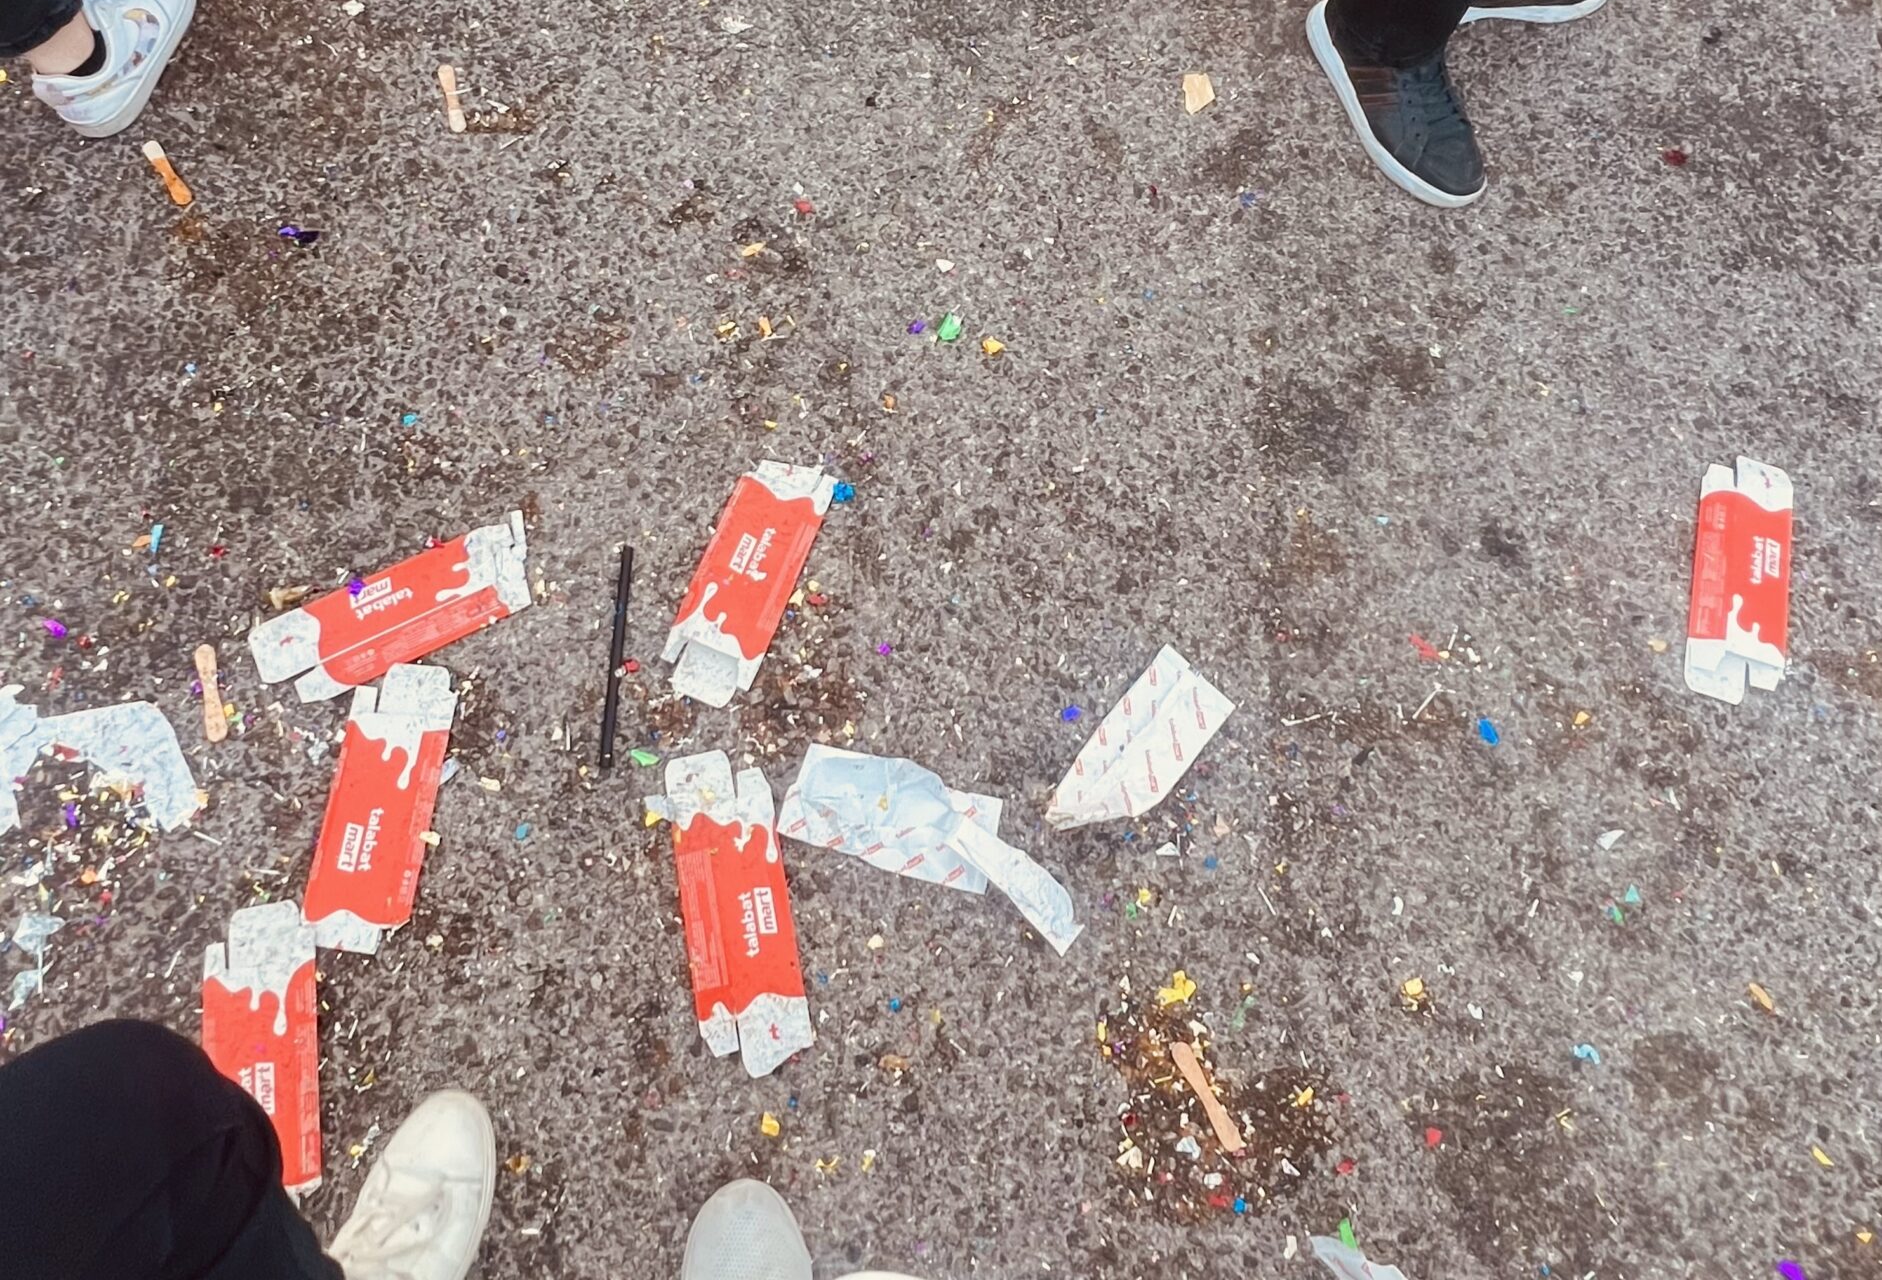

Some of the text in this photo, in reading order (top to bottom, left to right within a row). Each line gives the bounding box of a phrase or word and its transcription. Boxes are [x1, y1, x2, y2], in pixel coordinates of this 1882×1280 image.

[732, 536, 754, 569] mart
[1750, 536, 1764, 585] talabat
[355, 587, 414, 620] talabat
[341, 826, 359, 867] mart
[357, 807, 384, 872] talabat
[737, 891, 760, 958] talabat
[756, 890, 775, 930] mart
